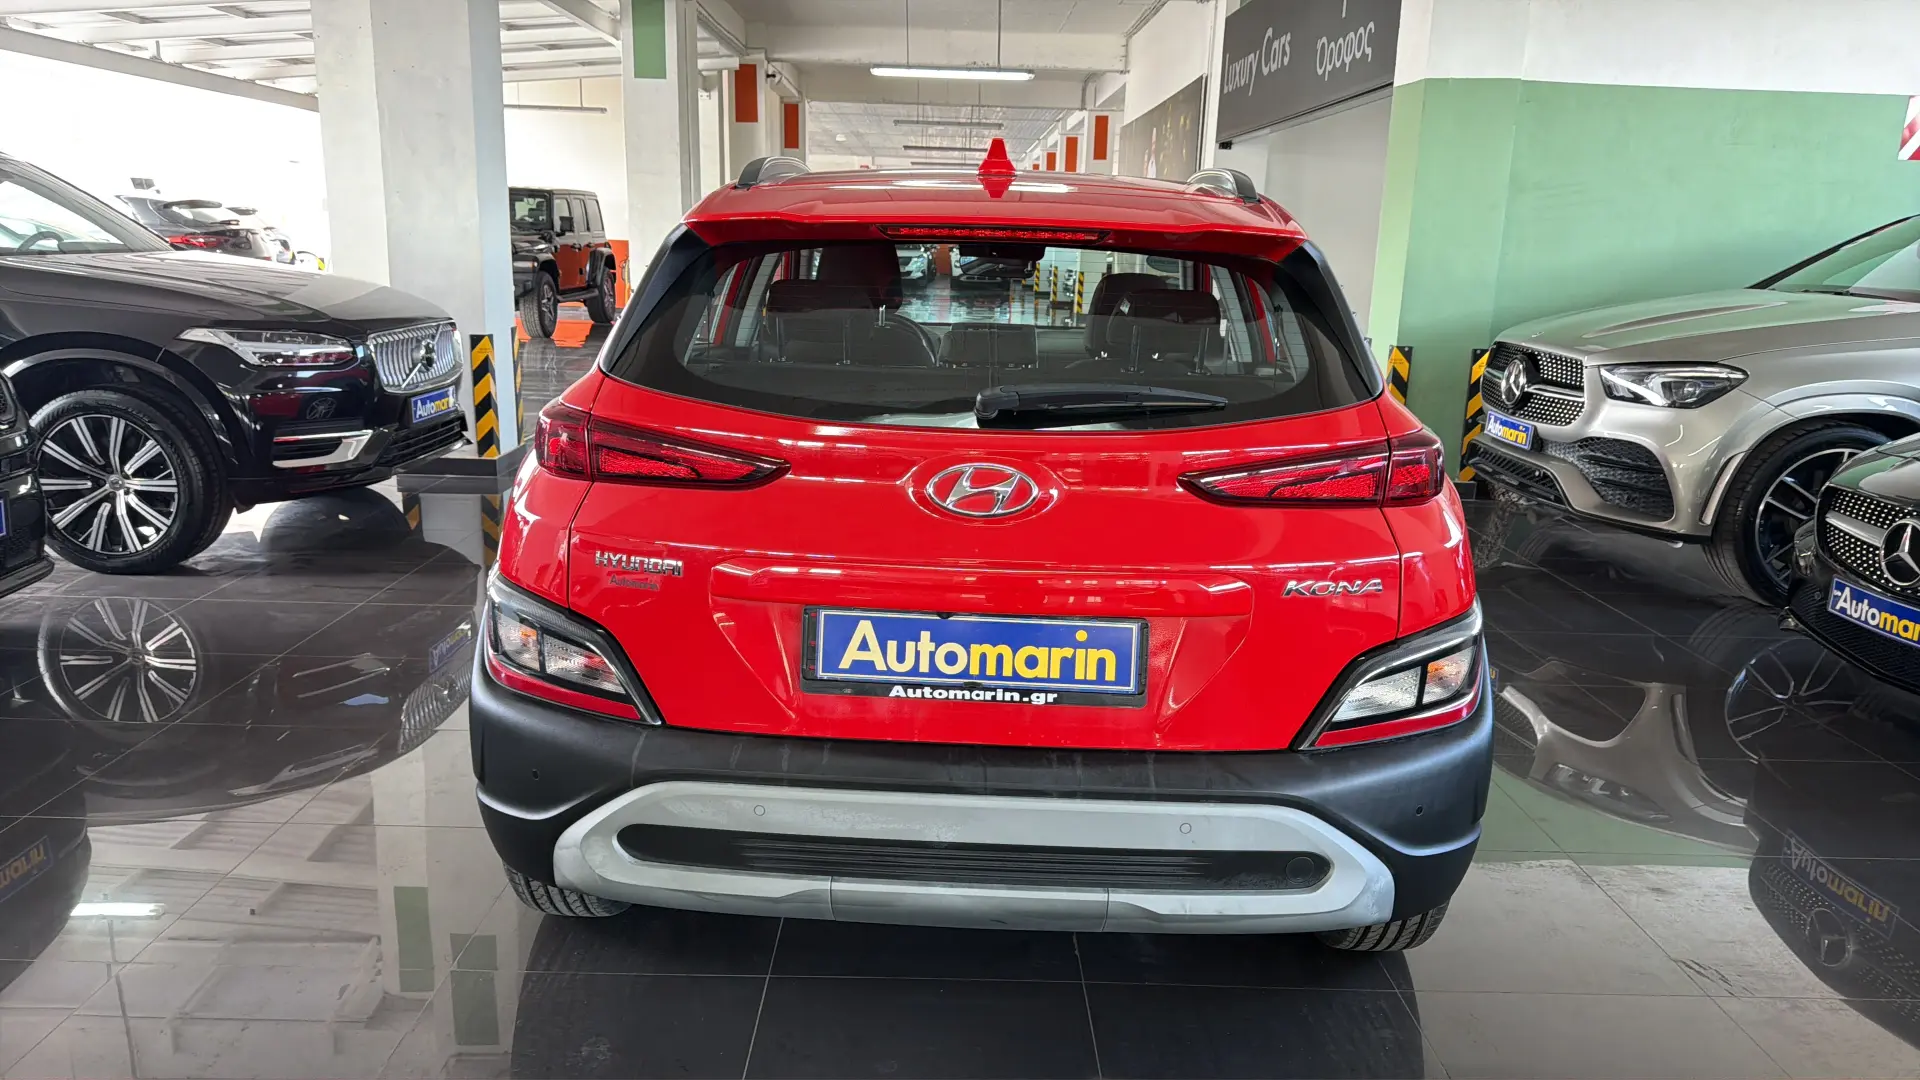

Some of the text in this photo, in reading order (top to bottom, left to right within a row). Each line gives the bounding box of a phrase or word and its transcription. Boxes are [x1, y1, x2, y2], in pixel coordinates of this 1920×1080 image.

[1223, 27, 1291, 96] Luxury Cars
[1488, 415, 1526, 445] Automarin
[595, 550, 683, 577] HYUNDAI
[1283, 579, 1383, 596] KONA
[838, 619, 1117, 682] Automarin
[888, 685, 1058, 706] Automarin.gr
